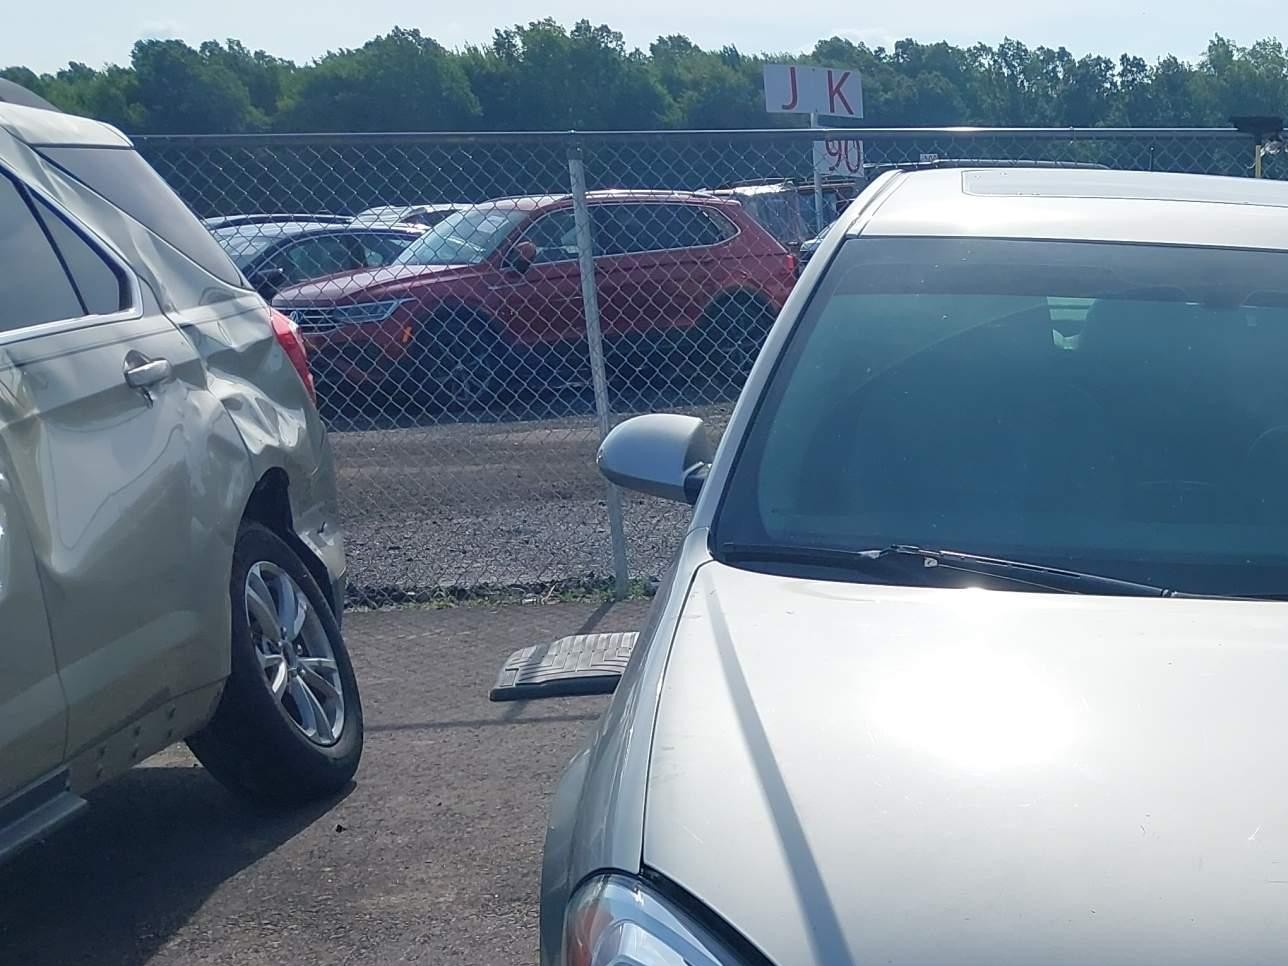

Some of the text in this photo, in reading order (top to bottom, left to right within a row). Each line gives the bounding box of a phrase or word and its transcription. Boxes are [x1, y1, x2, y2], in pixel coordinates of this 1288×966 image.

[781, 66, 854, 115] J K
[825, 137, 861, 173] 90
